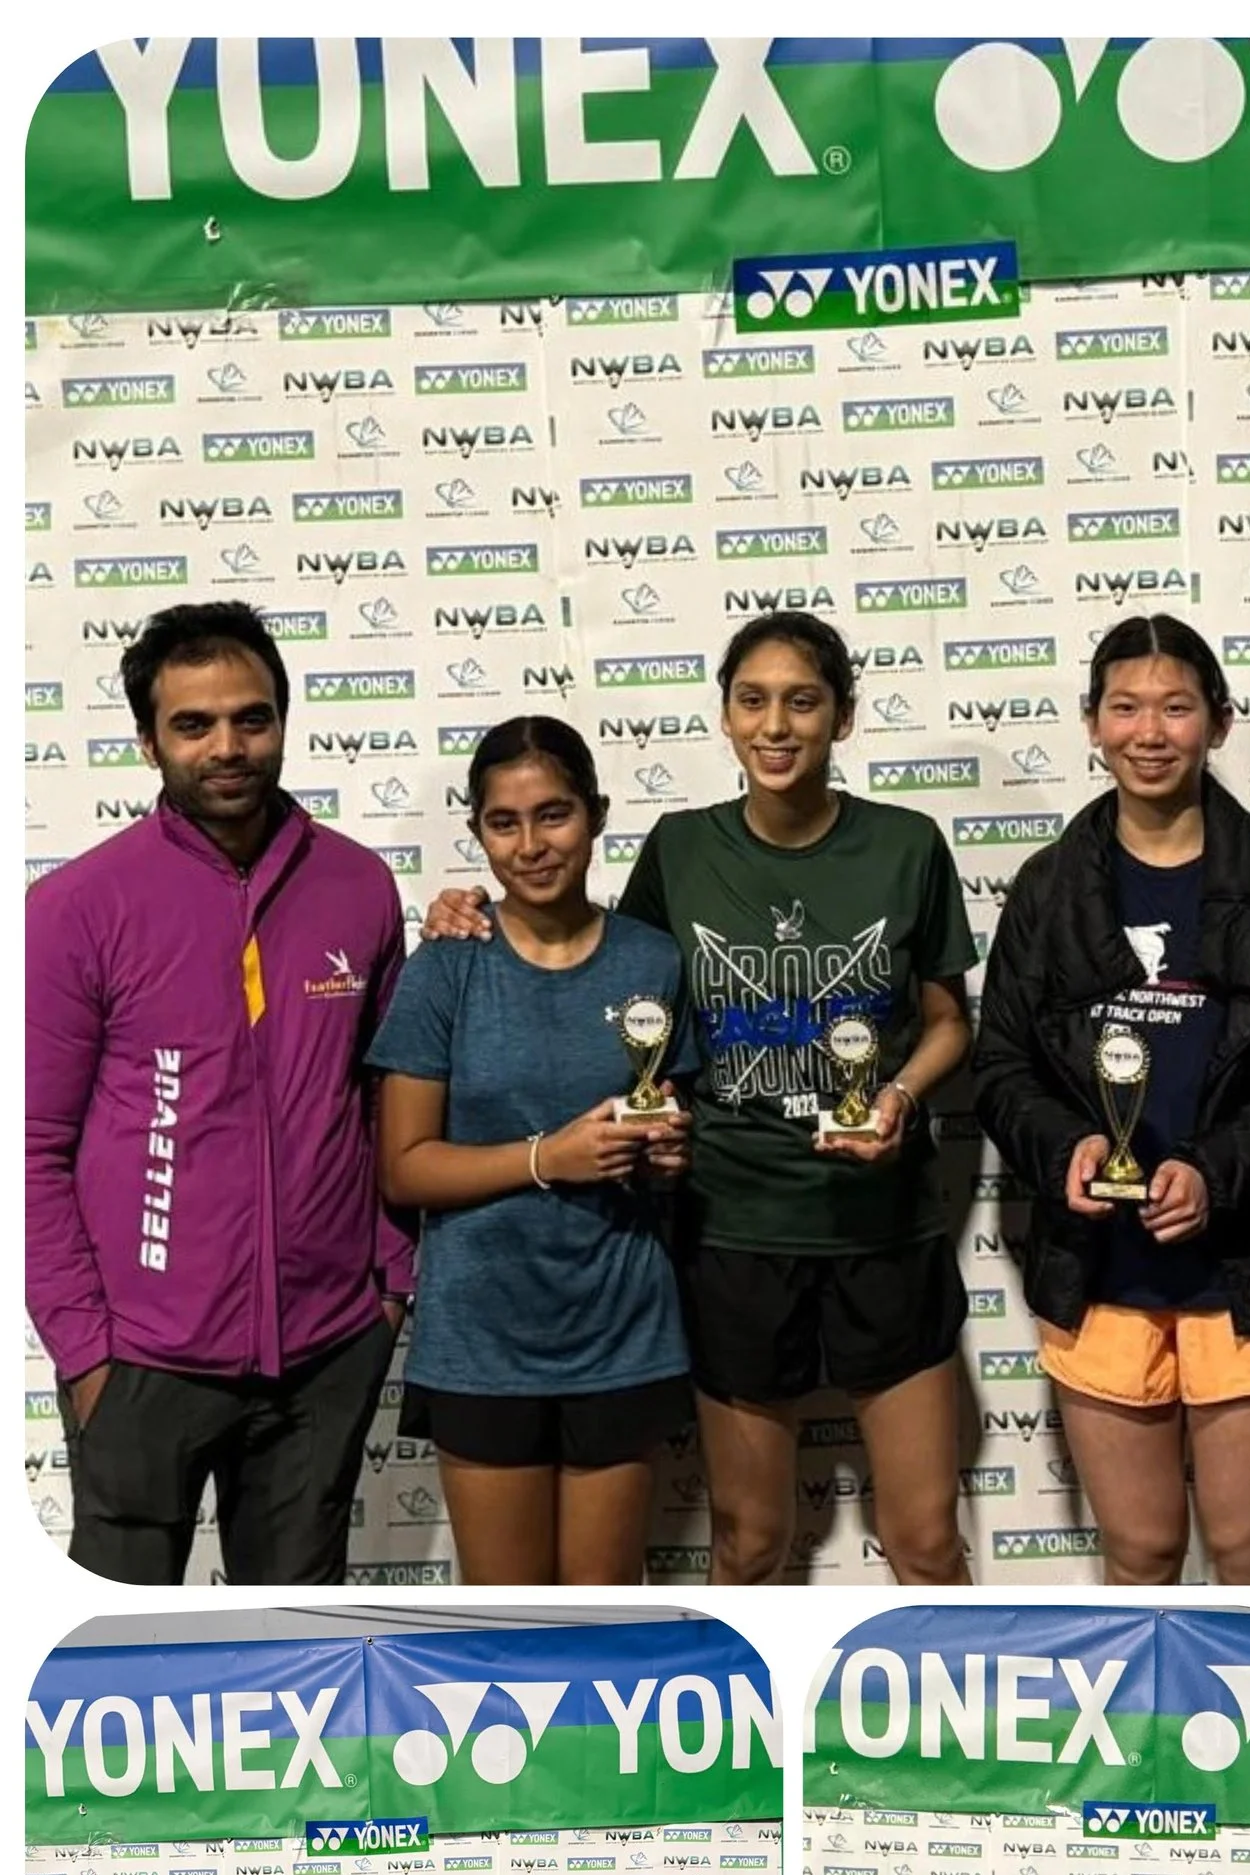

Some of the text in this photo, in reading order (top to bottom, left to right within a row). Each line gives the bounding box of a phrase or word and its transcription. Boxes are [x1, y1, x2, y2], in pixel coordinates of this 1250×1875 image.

[93, 37, 818, 199] YONEX
[844, 257, 998, 314] YONEX
[1099, 330, 1163, 353] YONEX
[110, 377, 169, 400] YONEX
[284, 370, 393, 392] NWBA
[462, 367, 521, 390] YONEX
[712, 408, 821, 432] NWBA
[424, 426, 533, 448] NWBA
[639, 658, 701, 681] YONEX
[350, 674, 410, 697] YONEX
[950, 699, 1058, 721] NWBA
[309, 731, 416, 753] NWBA
[1129, 990, 1207, 1008] NORTHWEST
[1106, 1005, 1145, 1022] TRACK
[1148, 1010, 1182, 1024] OPEN
[782, 1092, 819, 1119] 2023
[140, 1048, 181, 1272] BELLEVUE
[27, 1687, 342, 1797] YONEX
[1137, 1809, 1207, 1835] YONEX
[354, 1824, 421, 1849] YONEX
[682, 1830, 710, 1841] YONEX
[865, 1841, 918, 1854] NWBA
[948, 1844, 981, 1856] YONEX
[1004, 1842, 1056, 1854] NWBA
